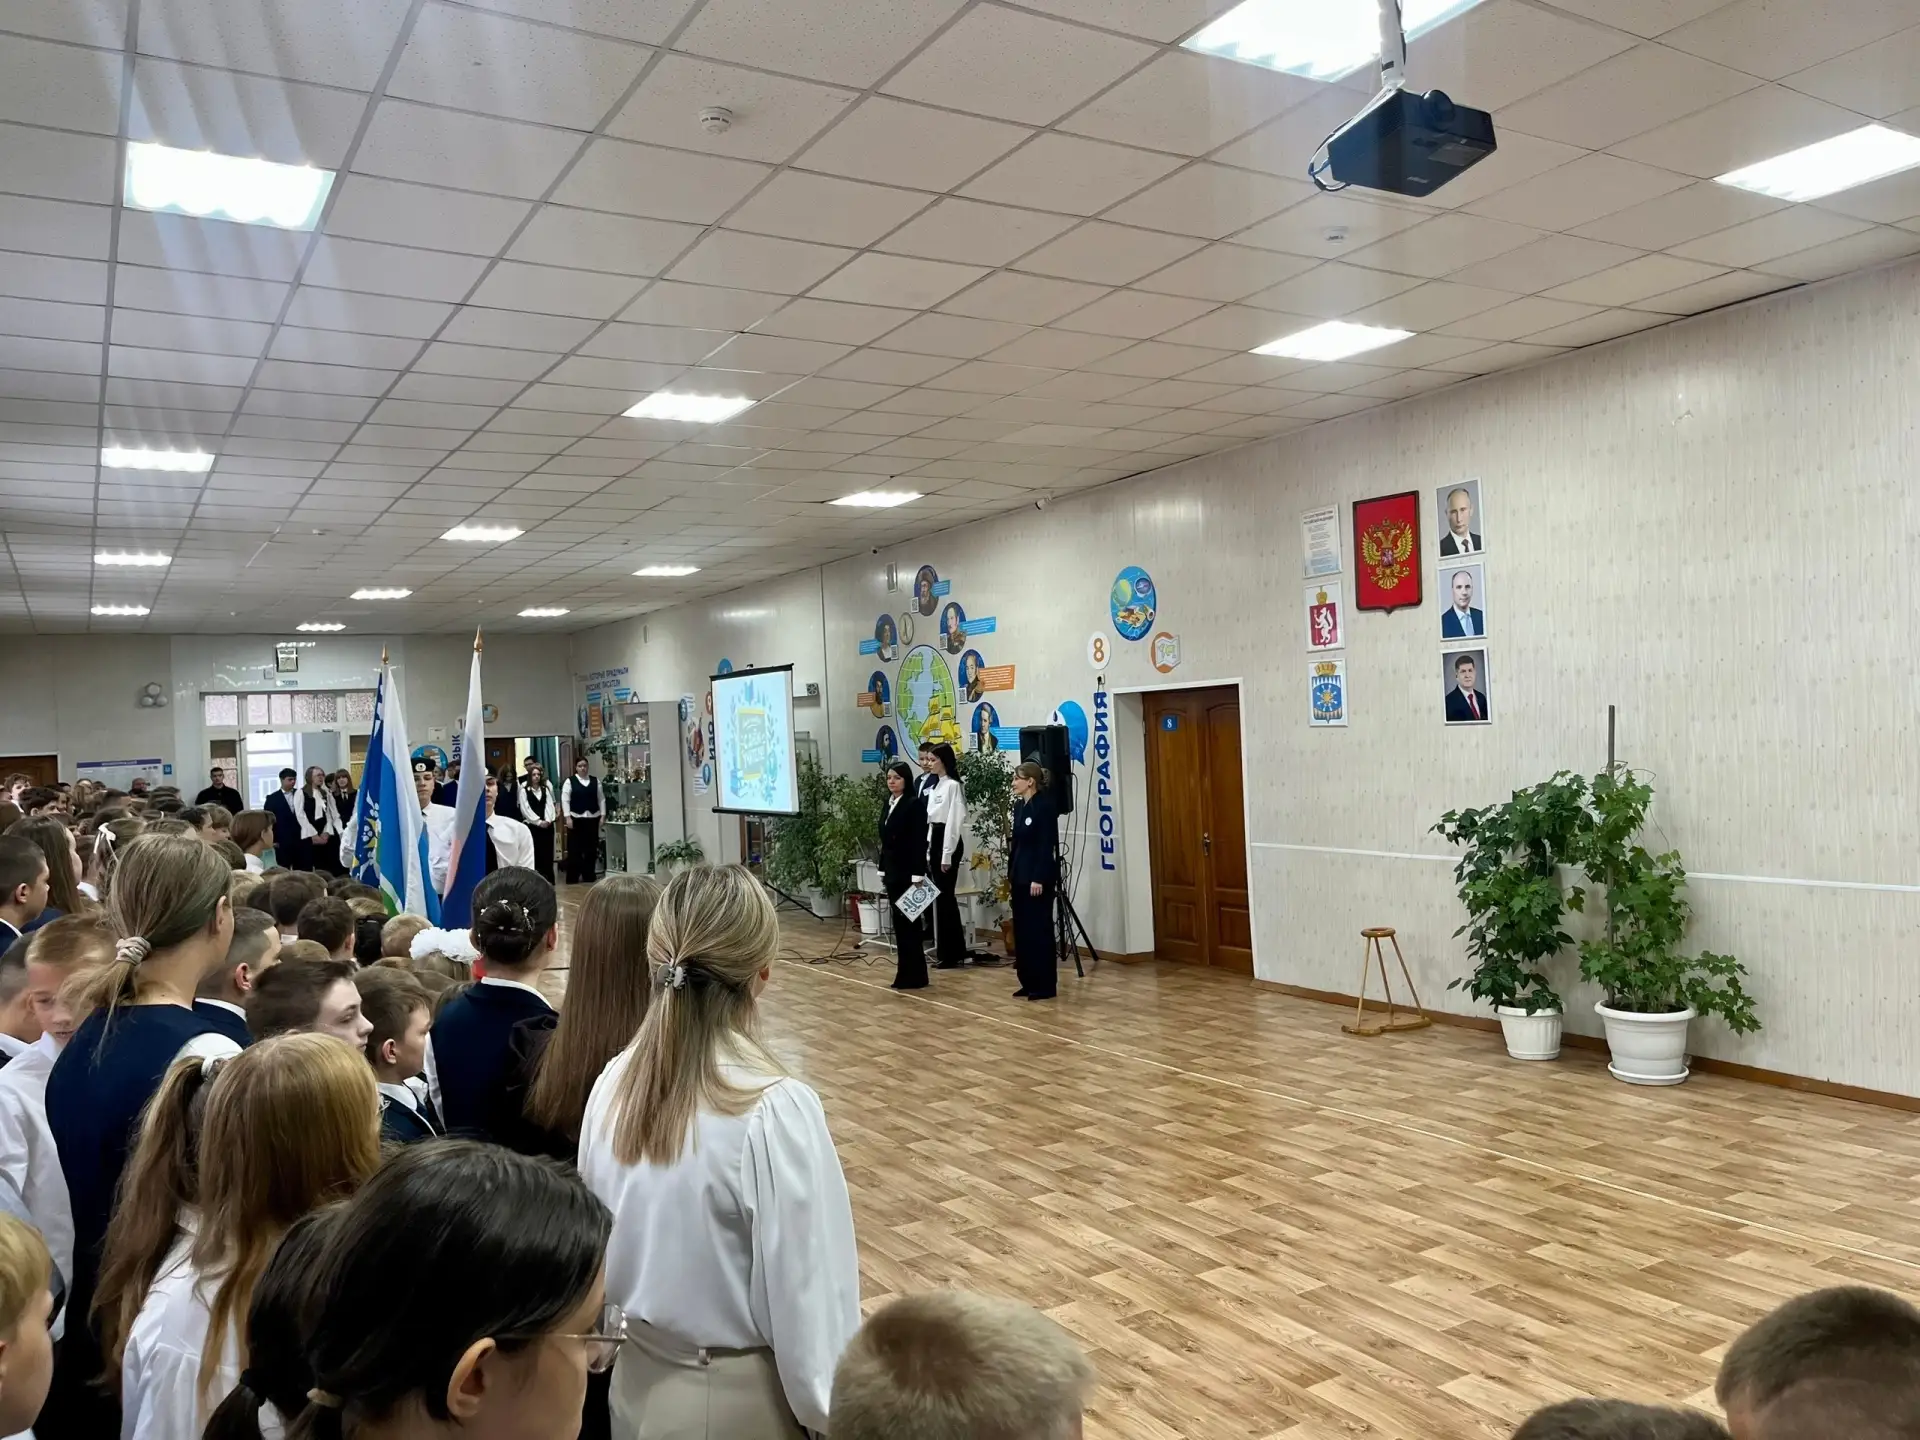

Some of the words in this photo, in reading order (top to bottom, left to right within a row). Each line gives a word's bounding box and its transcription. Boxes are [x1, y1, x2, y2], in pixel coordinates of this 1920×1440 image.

[1094, 638, 1105, 662] 8
[452, 735, 461, 760] ЗЫК
[1094, 692, 1116, 870] ГЕОГРАФИЯ
